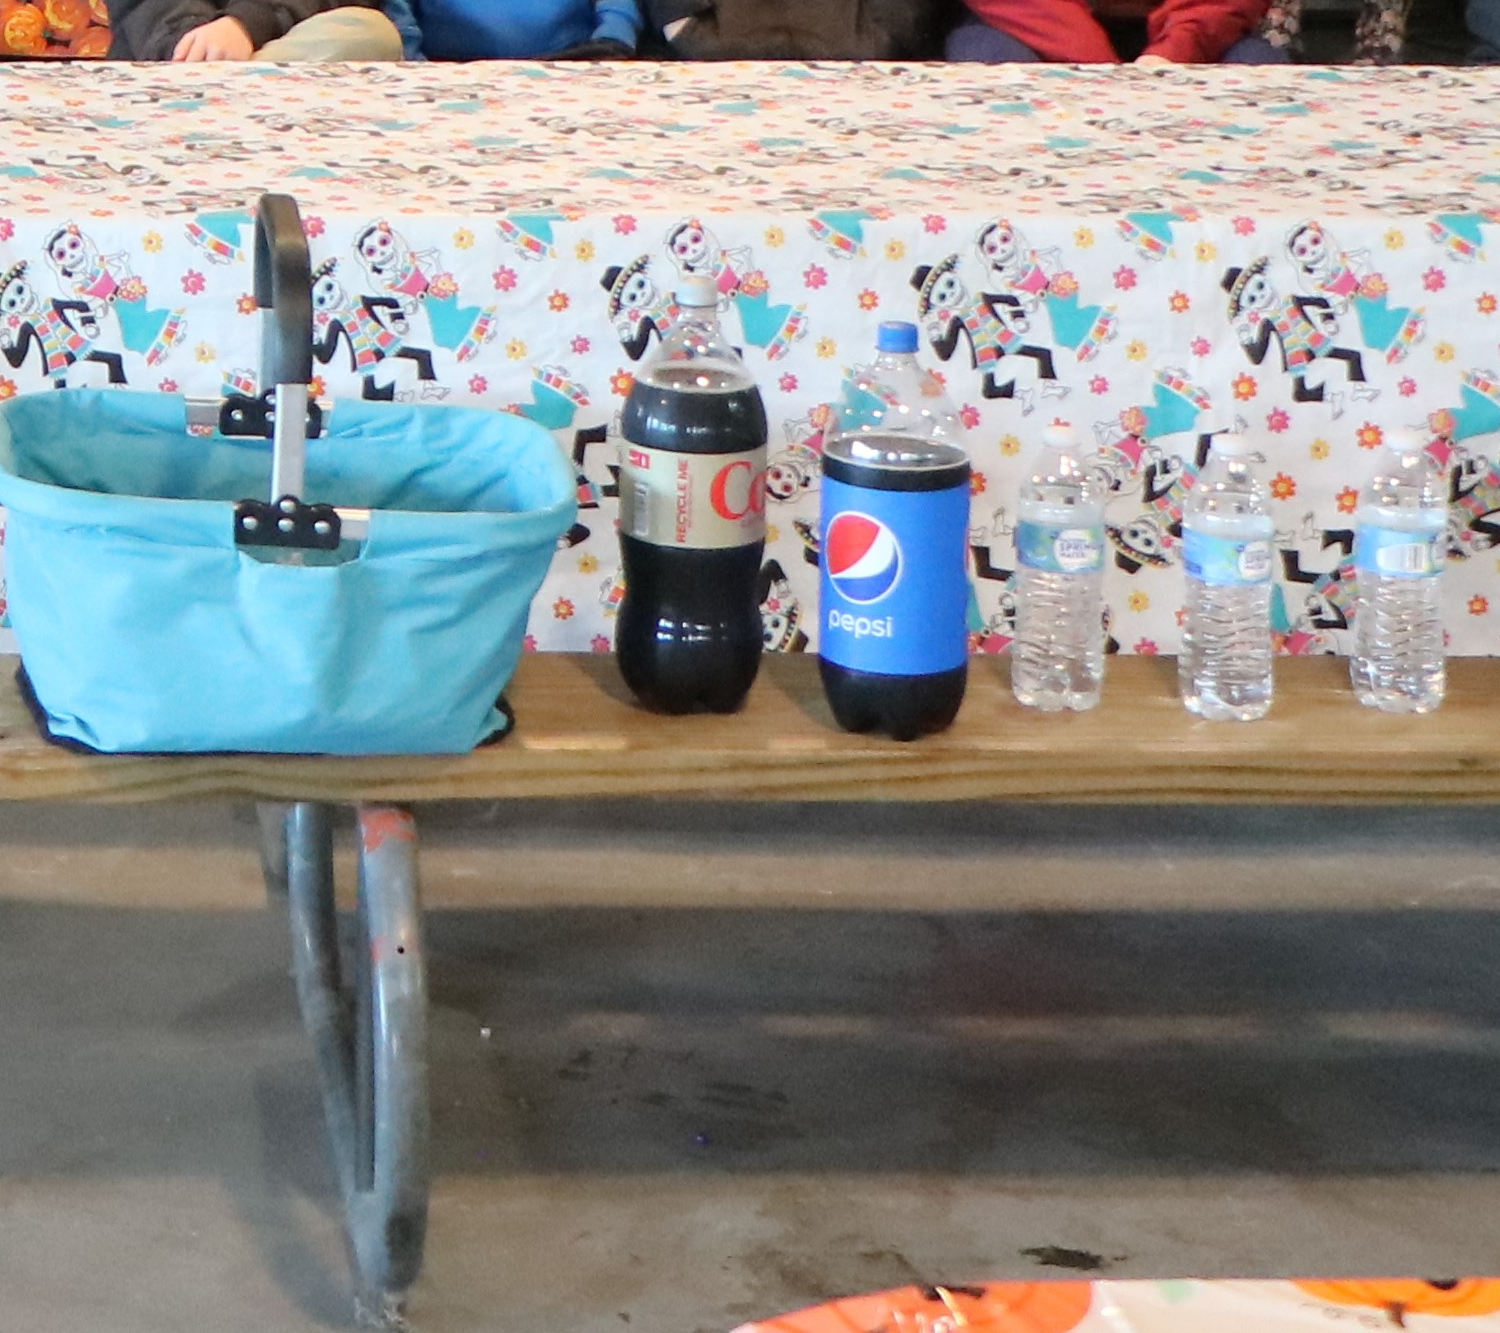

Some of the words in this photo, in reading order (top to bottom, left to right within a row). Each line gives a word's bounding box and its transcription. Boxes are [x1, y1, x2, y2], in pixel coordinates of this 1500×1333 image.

[680, 459, 690, 480] ME
[675, 483, 688, 543] RECYCLE
[828, 609, 894, 639] pepsi
